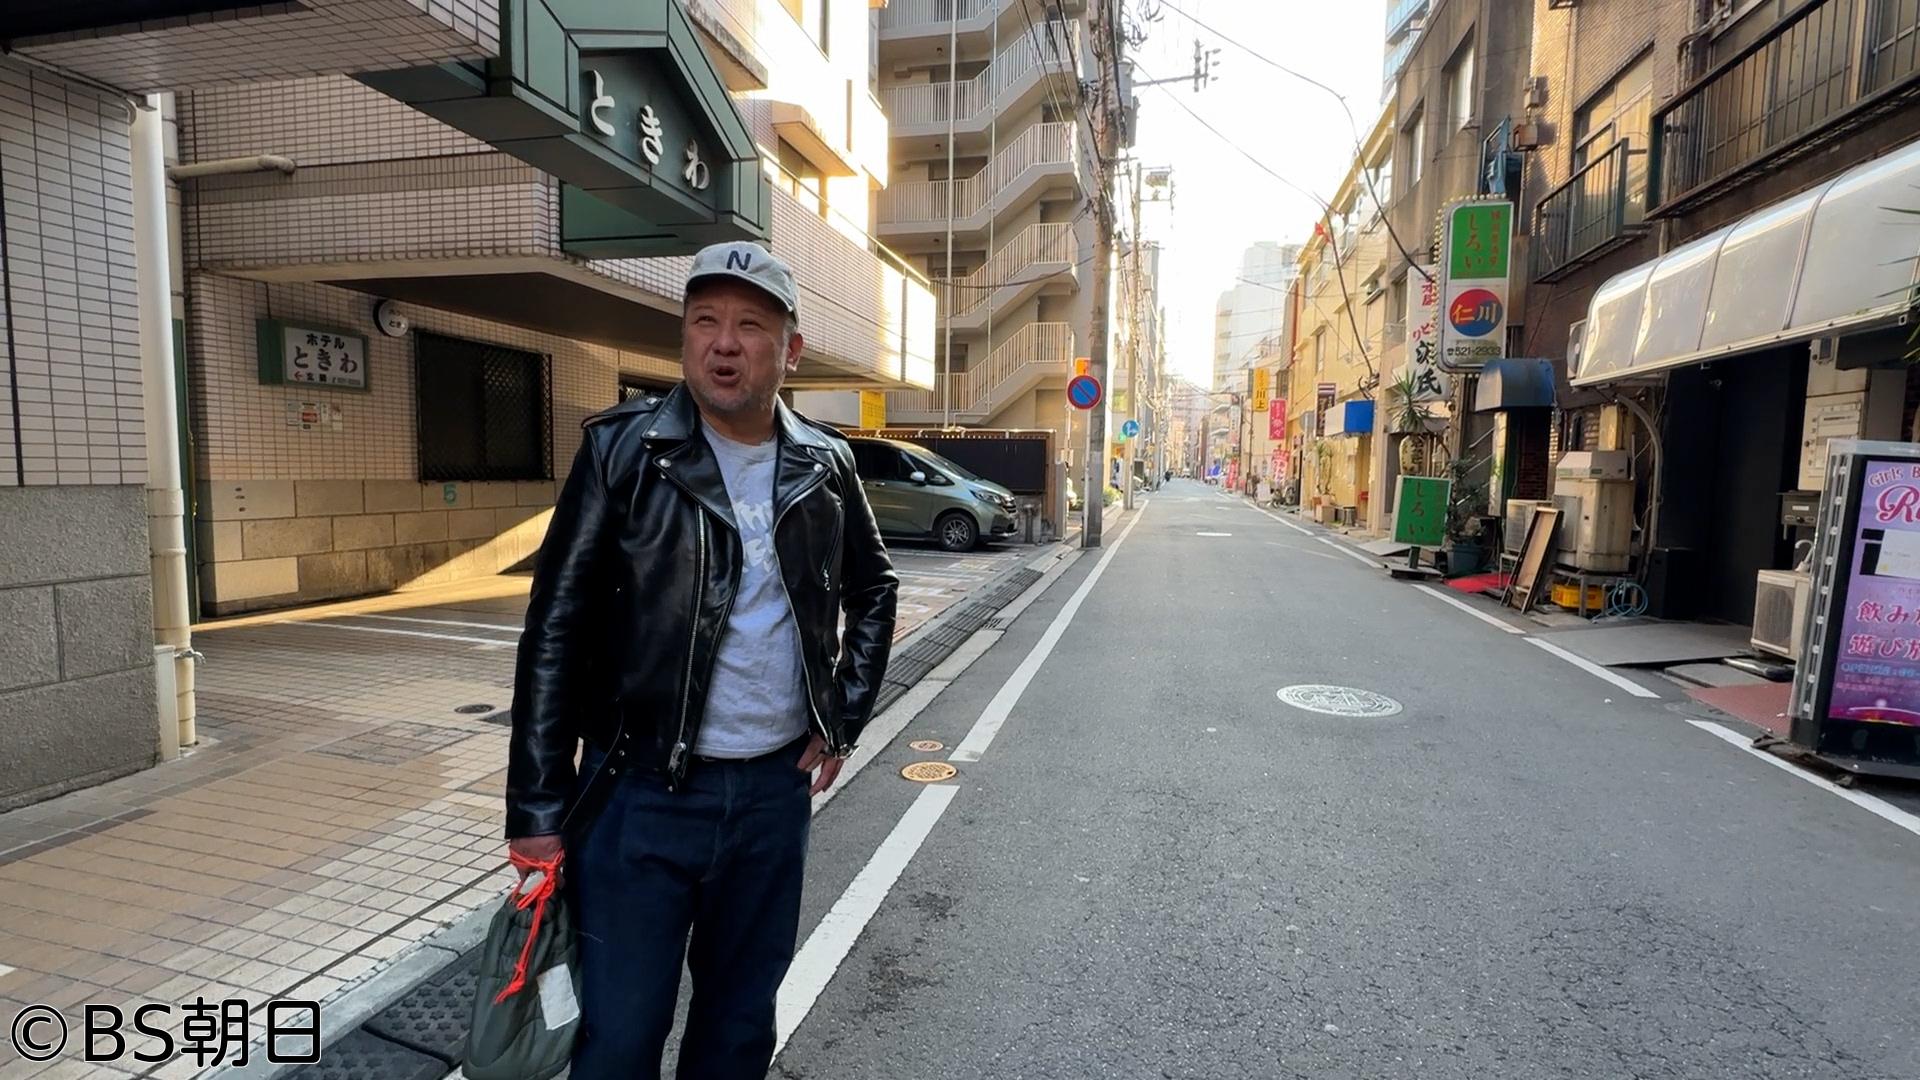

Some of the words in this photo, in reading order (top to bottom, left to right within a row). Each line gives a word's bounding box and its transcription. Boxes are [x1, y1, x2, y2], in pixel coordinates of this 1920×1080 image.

[588, 69, 711, 191] ときわ
[726, 250, 752, 271] N
[1451, 303, 1498, 324] 仁川
[306, 332, 345, 350] ホテル
[293, 345, 359, 374] ときわ
[1868, 466, 1905, 487] Girls
[443, 484, 457, 505] 5
[1876, 484, 1920, 523] R
[1407, 481, 1426, 536] しろい
[1856, 600, 1920, 626] 飲み
